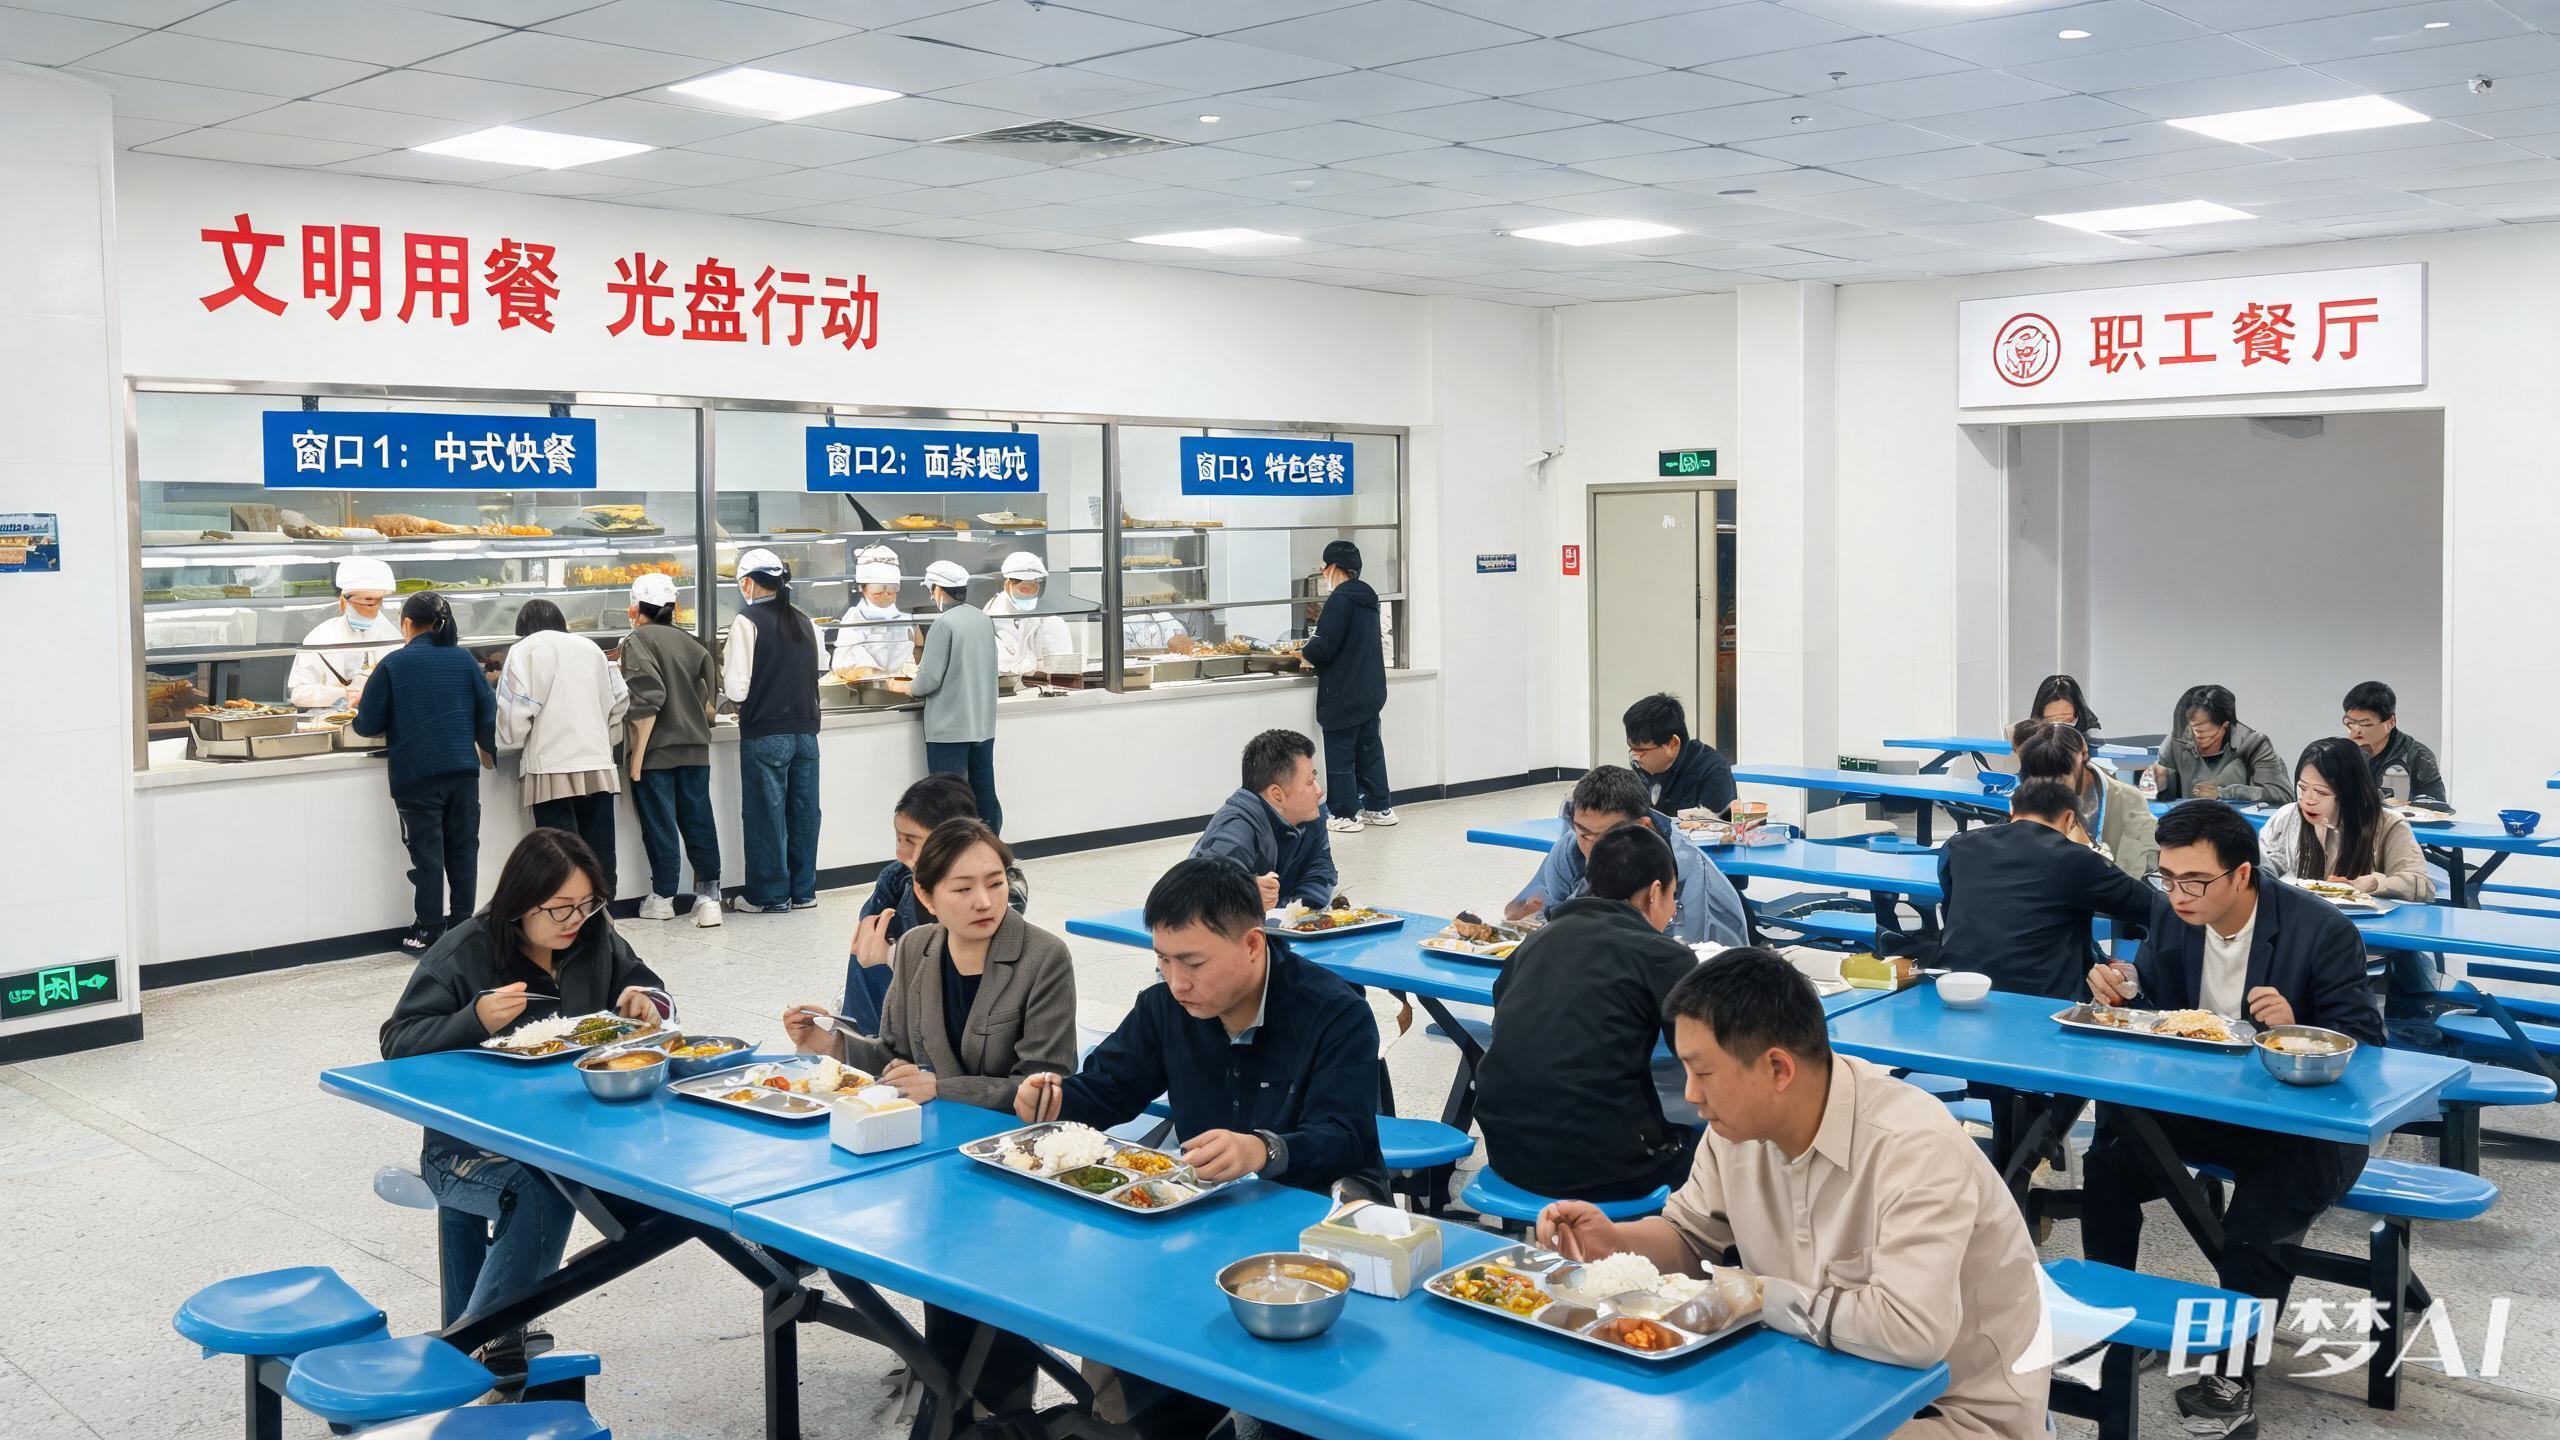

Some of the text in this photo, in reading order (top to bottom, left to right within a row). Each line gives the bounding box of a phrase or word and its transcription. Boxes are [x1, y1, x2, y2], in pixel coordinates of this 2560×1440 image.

[200, 213, 879, 350] 文明用餐 光盘行动
[2089, 297, 2379, 375] 职工餐厅
